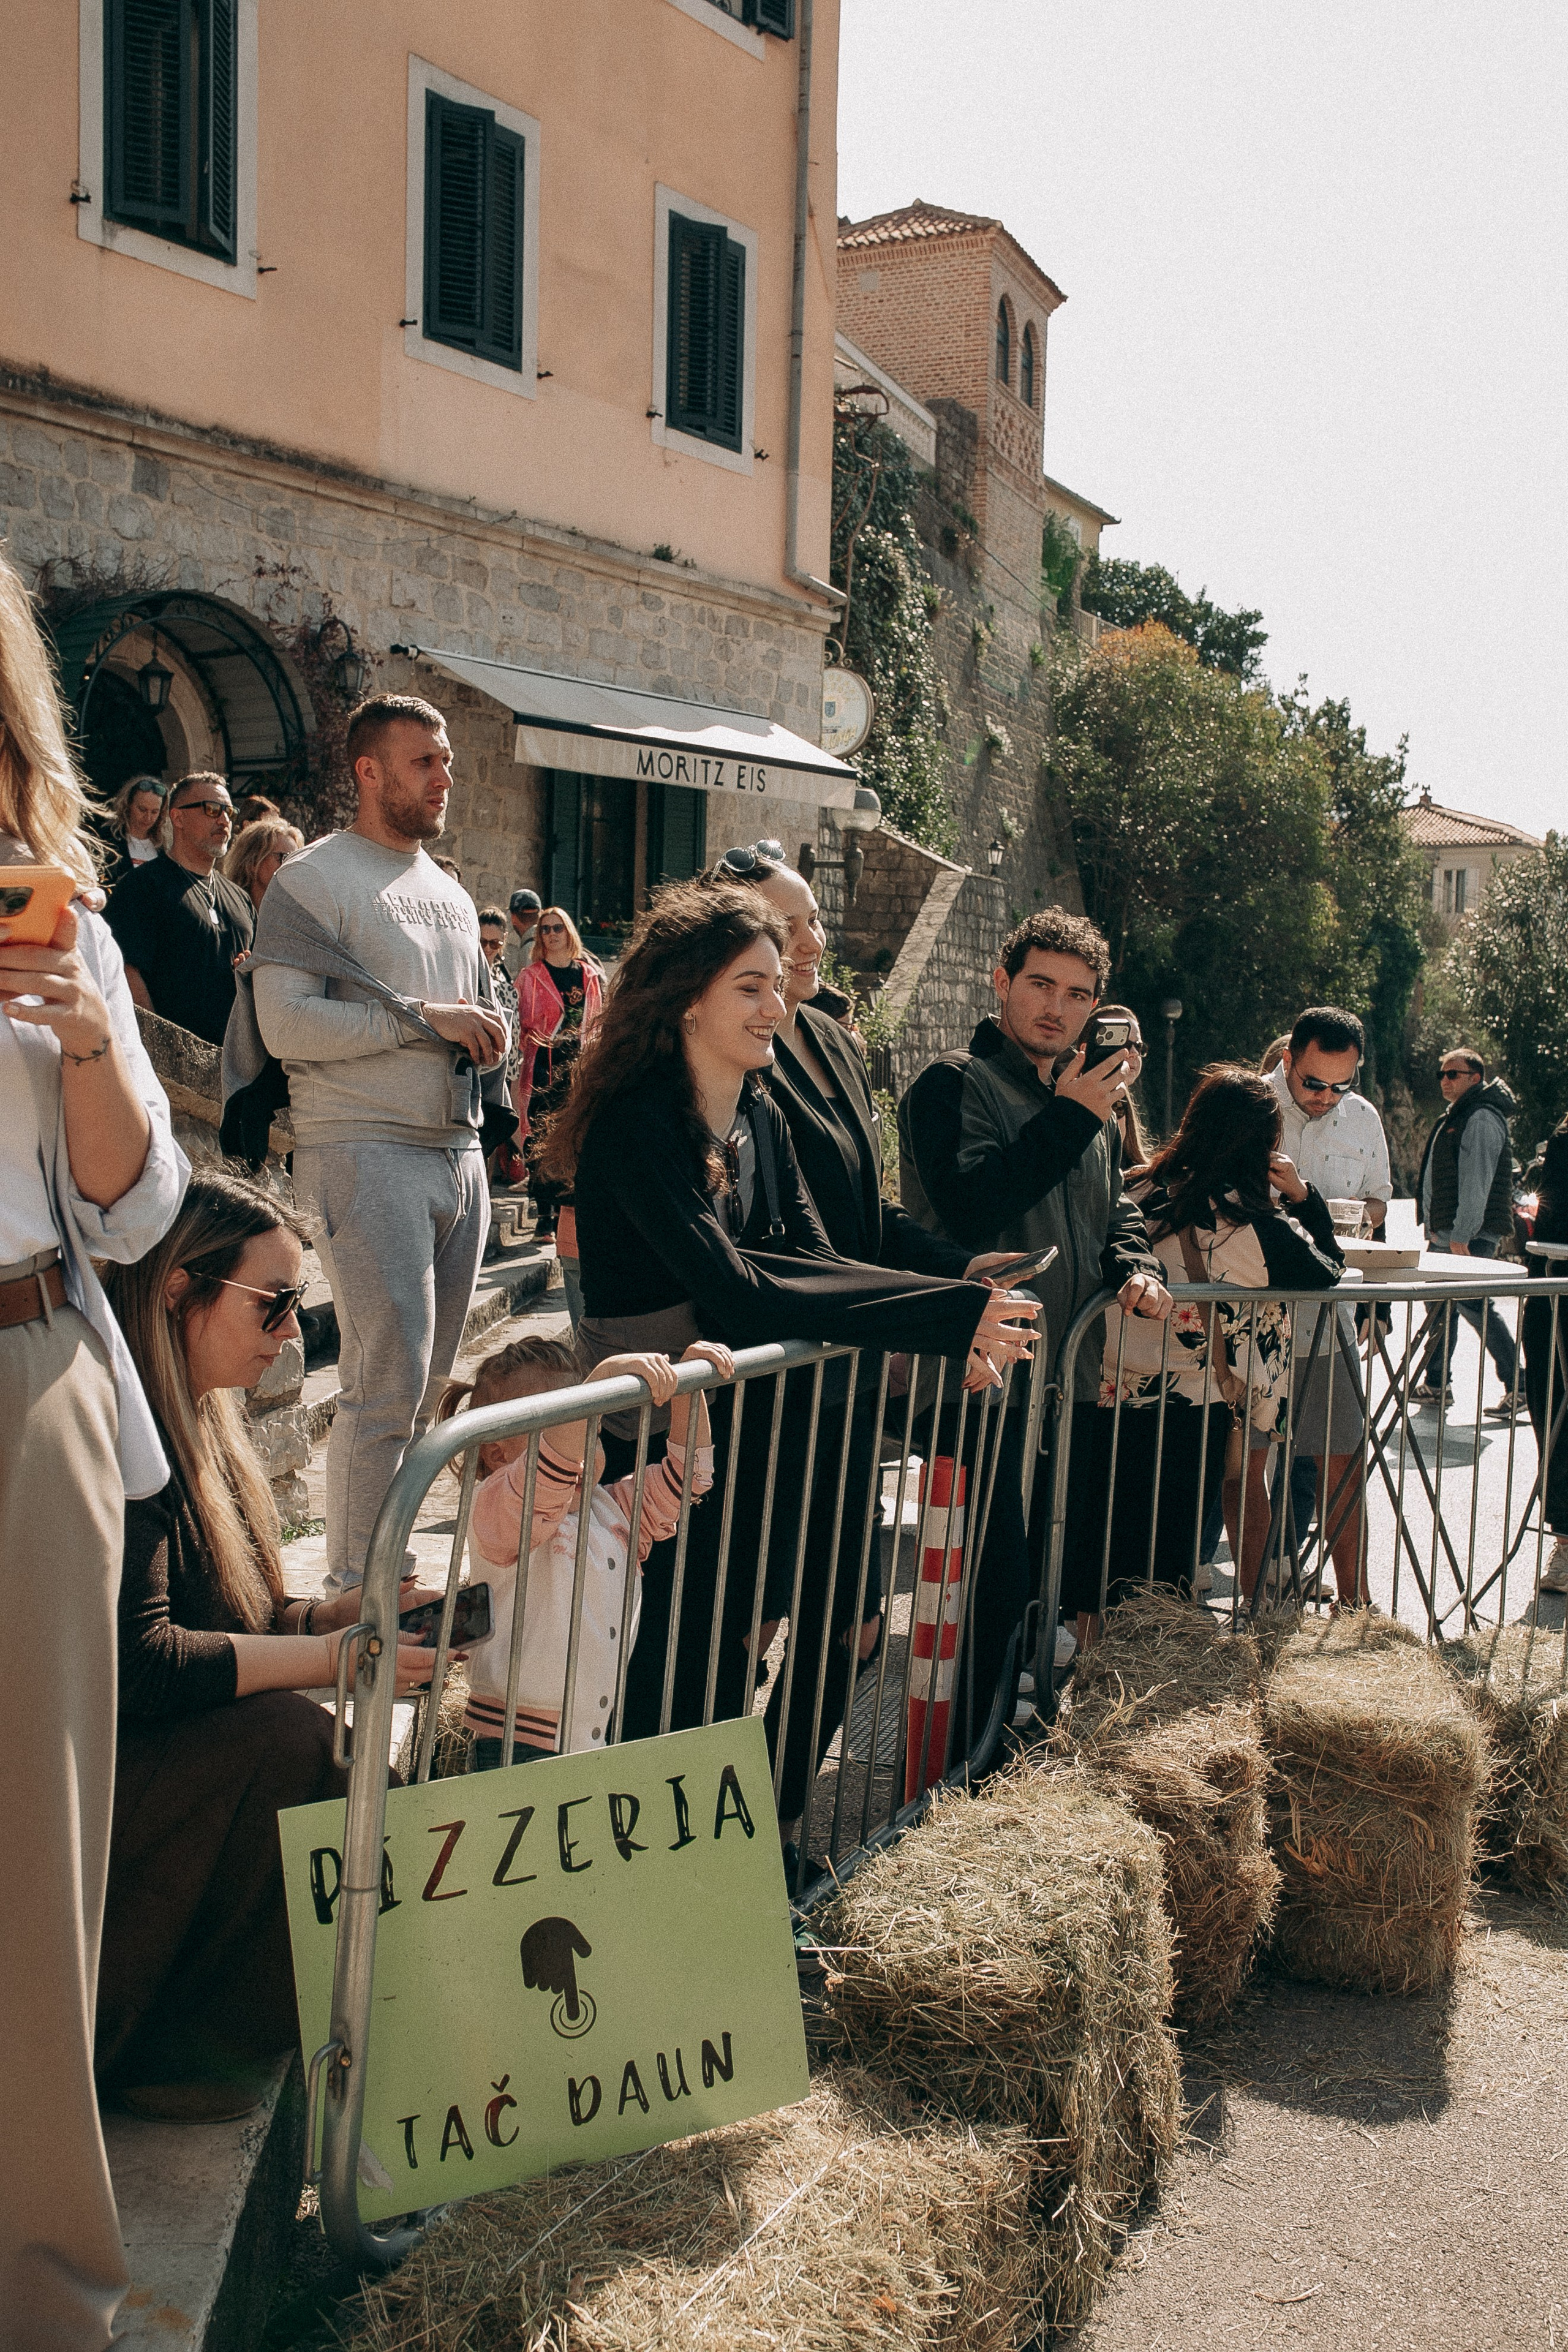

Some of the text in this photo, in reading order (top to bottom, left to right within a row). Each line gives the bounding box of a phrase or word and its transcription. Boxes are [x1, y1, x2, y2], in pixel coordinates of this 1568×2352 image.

[636, 748, 766, 793] MORITZ EIS
[310, 1764, 755, 1925] PIZZERIA
[397, 2031, 736, 2169] TAČ DAUN
